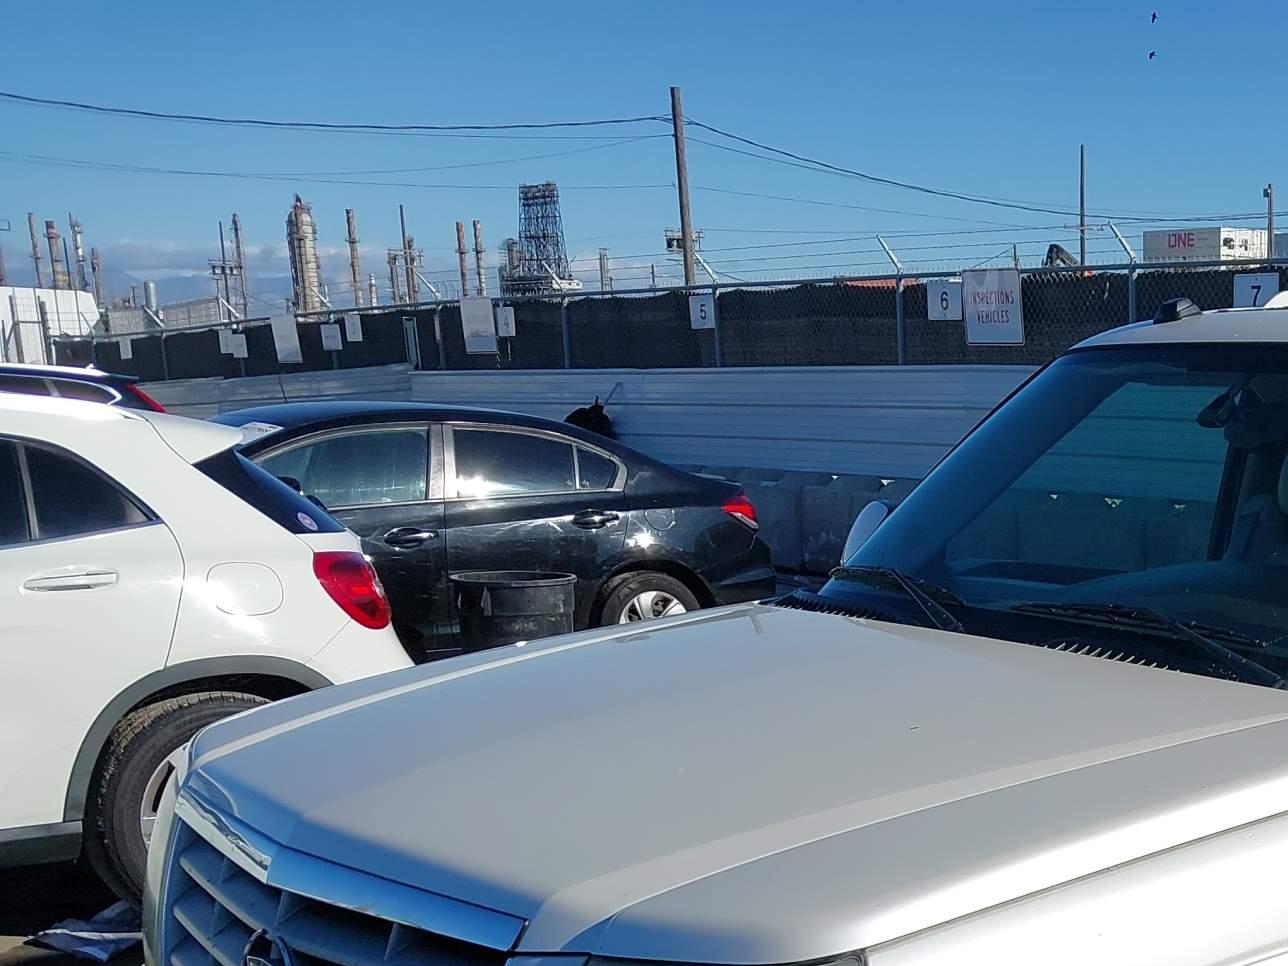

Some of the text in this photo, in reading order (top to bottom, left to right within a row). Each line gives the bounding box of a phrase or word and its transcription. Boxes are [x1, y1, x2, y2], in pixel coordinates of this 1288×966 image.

[1168, 232, 1195, 248] ONE
[940, 291, 949, 310] 6
[970, 291, 1015, 305] INSPECTIONS
[1250, 285, 1262, 307] 7
[699, 303, 707, 320] 5
[976, 309, 1010, 324] VEHICLES
